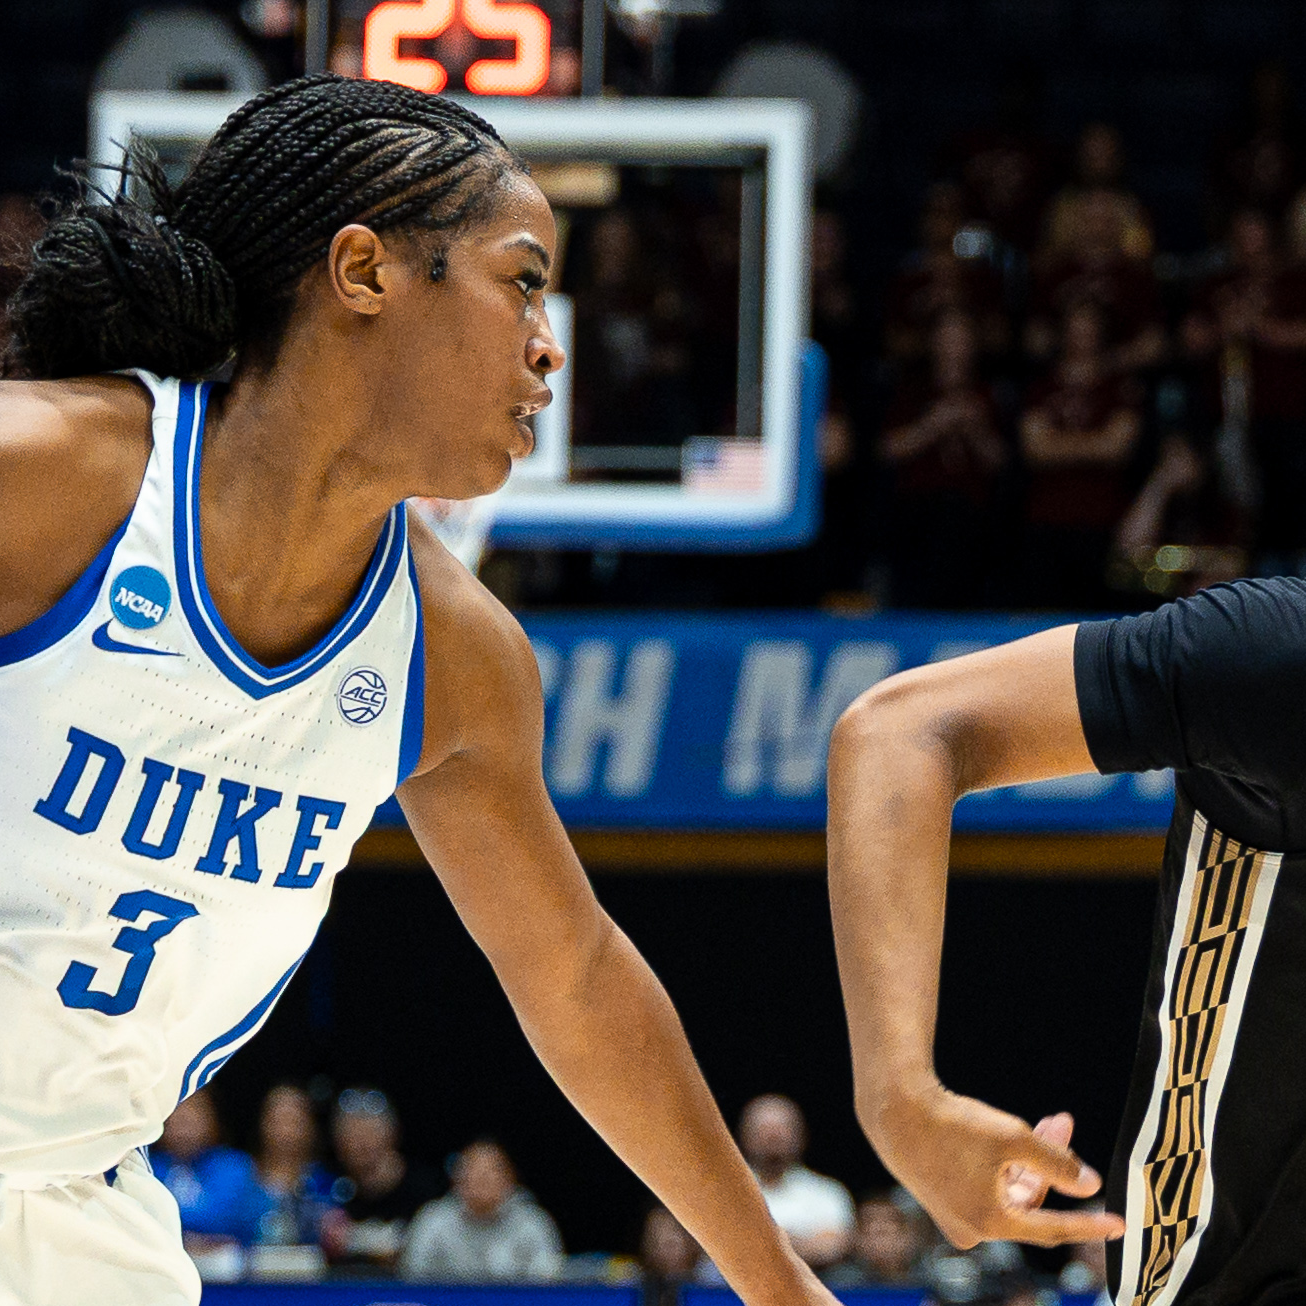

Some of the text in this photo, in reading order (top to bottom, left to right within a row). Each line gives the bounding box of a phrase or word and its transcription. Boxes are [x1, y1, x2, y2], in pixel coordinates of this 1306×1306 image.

[114, 586, 165, 623] NCAA
[344, 685, 387, 705] ACC
[32, 725, 347, 889] DUKE
[56, 889, 201, 1017] 3
